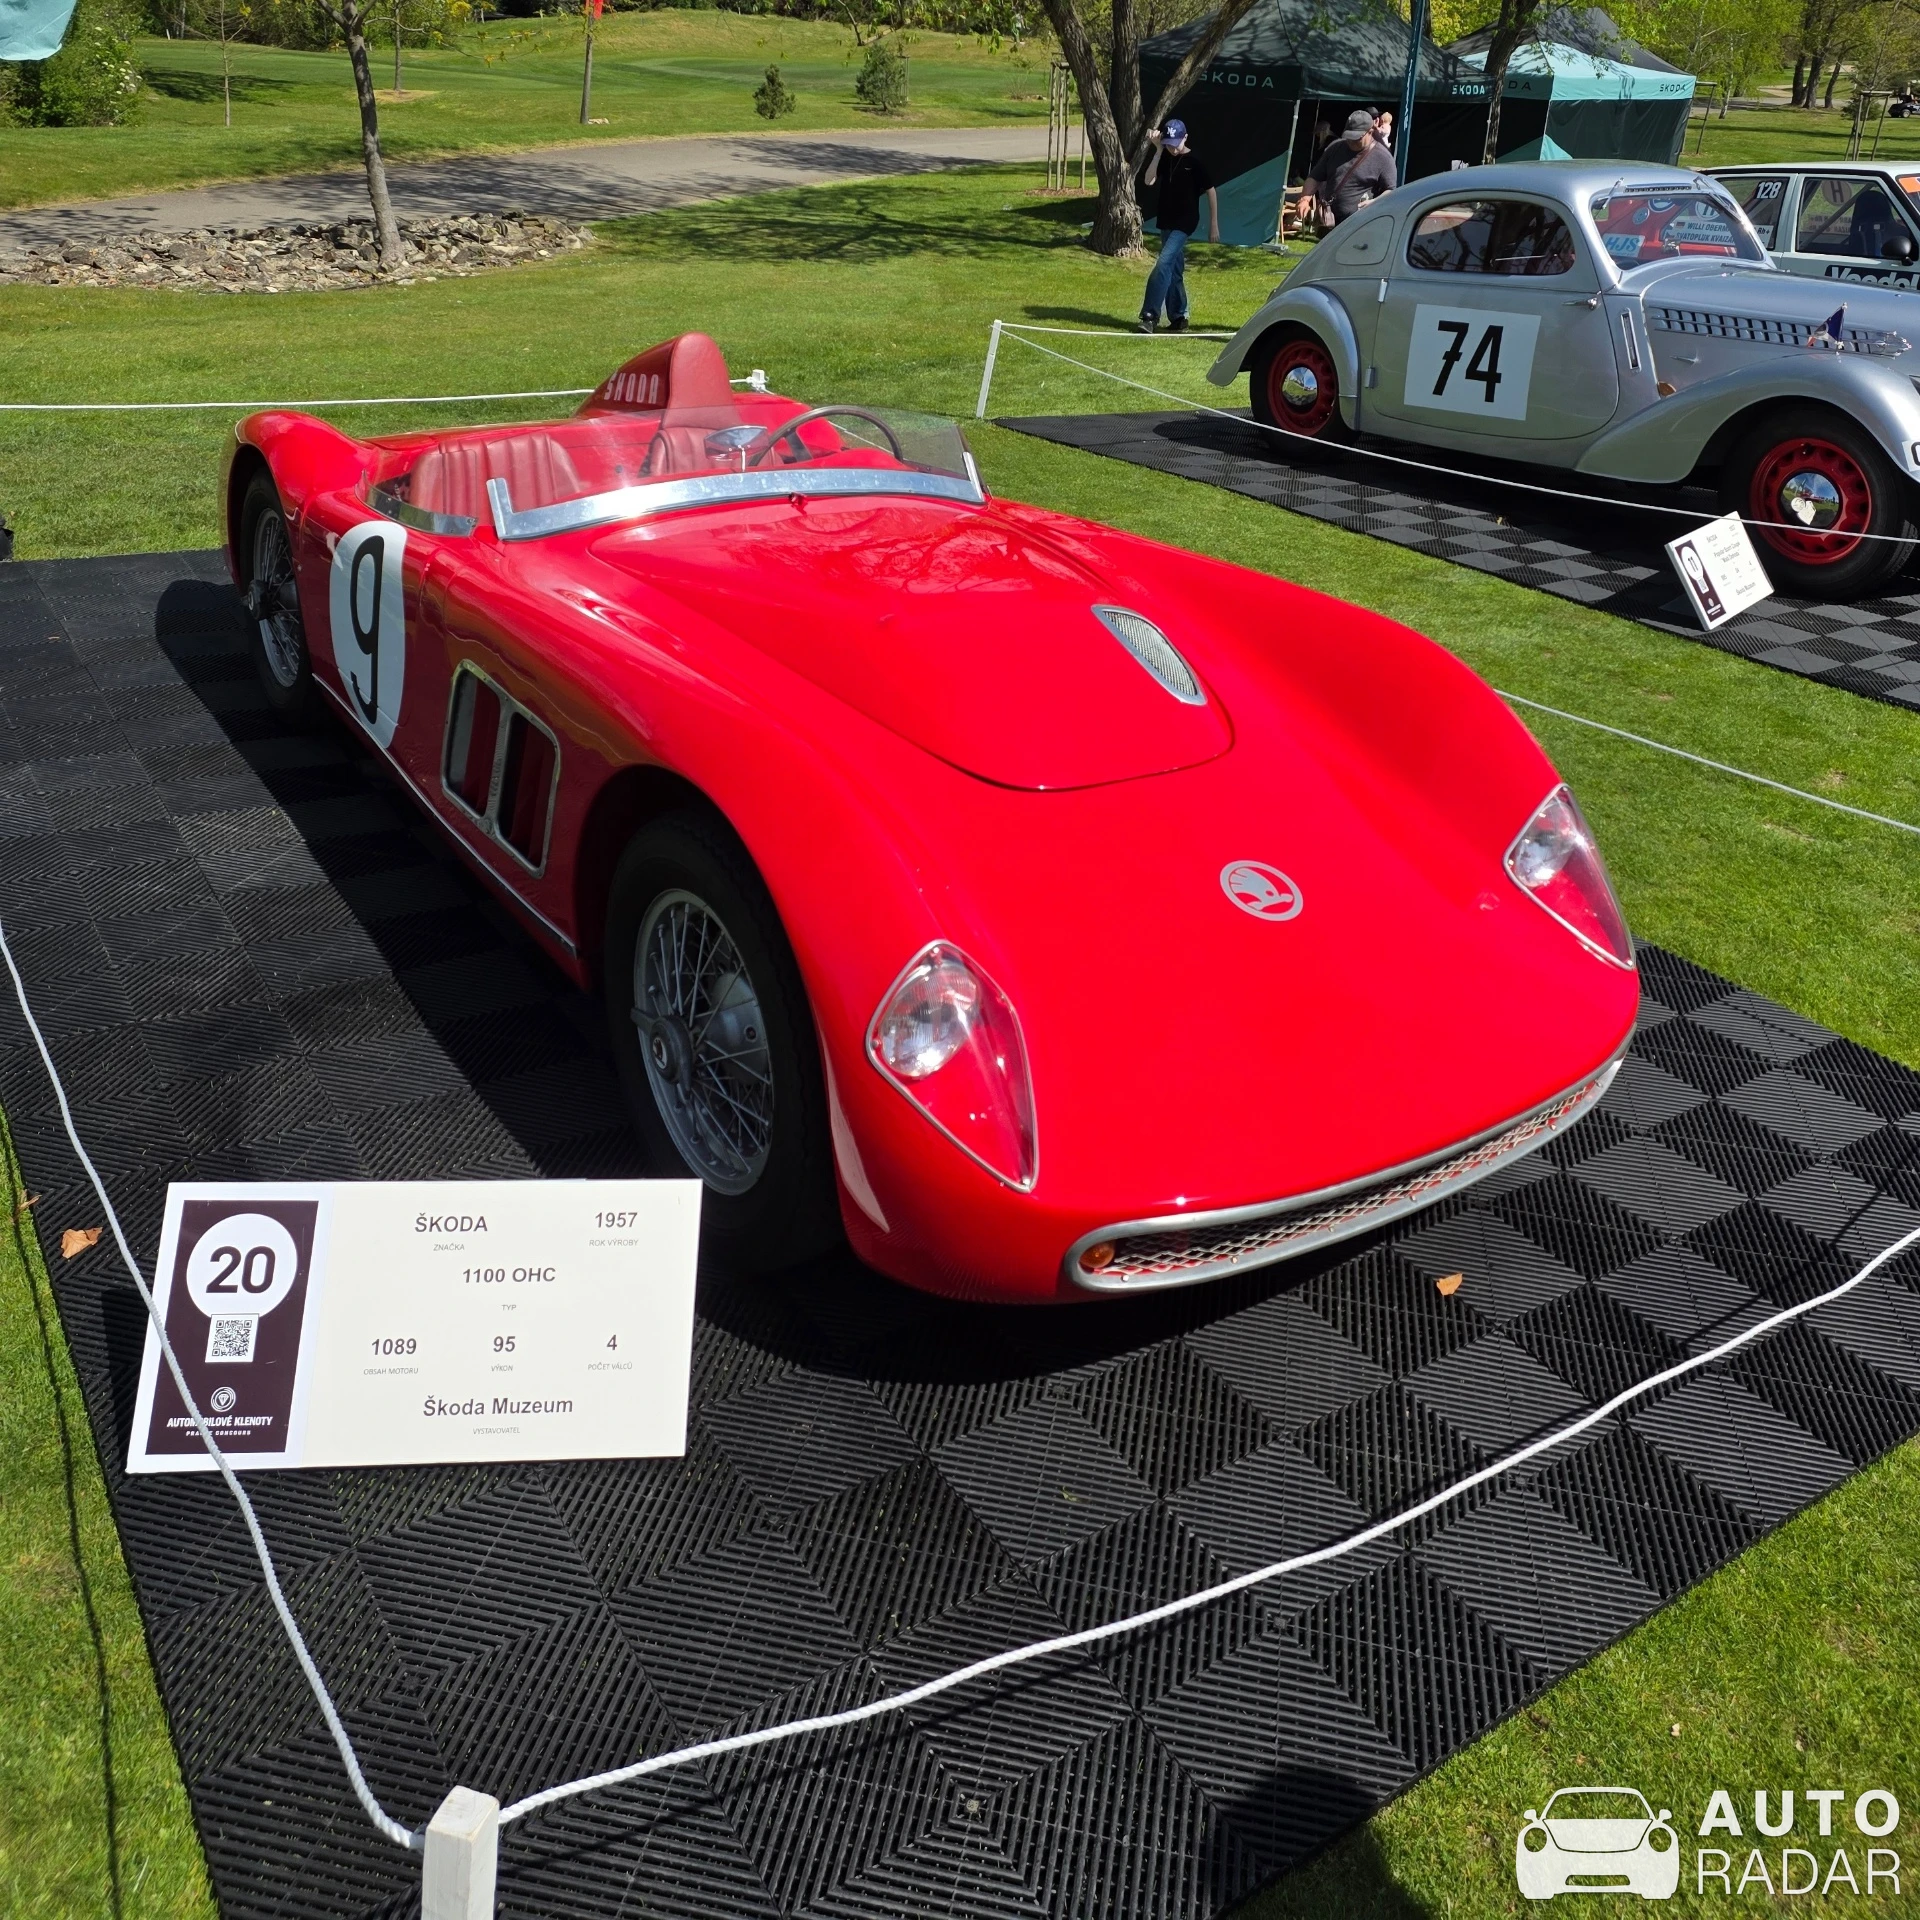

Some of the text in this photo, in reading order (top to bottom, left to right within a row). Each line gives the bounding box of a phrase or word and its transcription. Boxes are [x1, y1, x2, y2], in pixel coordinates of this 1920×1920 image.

[1756, 181, 1782, 199] 128
[1605, 236, 1640, 252] HJS
[1432, 320, 1504, 403] 74
[350, 535, 385, 725] 9
[414, 1212, 488, 1233] ŠKODA
[594, 1211, 638, 1228] 1957
[433, 1242, 465, 1251] ZNAČKA
[589, 1238, 639, 1247] ROK VÝROBY
[206, 1246, 276, 1294] 20
[462, 1267, 556, 1283] 1100 OHC
[371, 1338, 417, 1356] 1089
[492, 1335, 516, 1353] 95
[606, 1334, 618, 1351] 4
[363, 1367, 419, 1375] OBSAH MOTORU
[490, 1363, 513, 1372] VÝKON
[587, 1361, 633, 1371] POČET VÁLCŮ
[423, 1395, 573, 1416] Škoda Muzeum
[166, 1415, 274, 1427] AUTOMBILOVÉ KLENOTY
[473, 1427, 520, 1435] VYSTAVOVATEL
